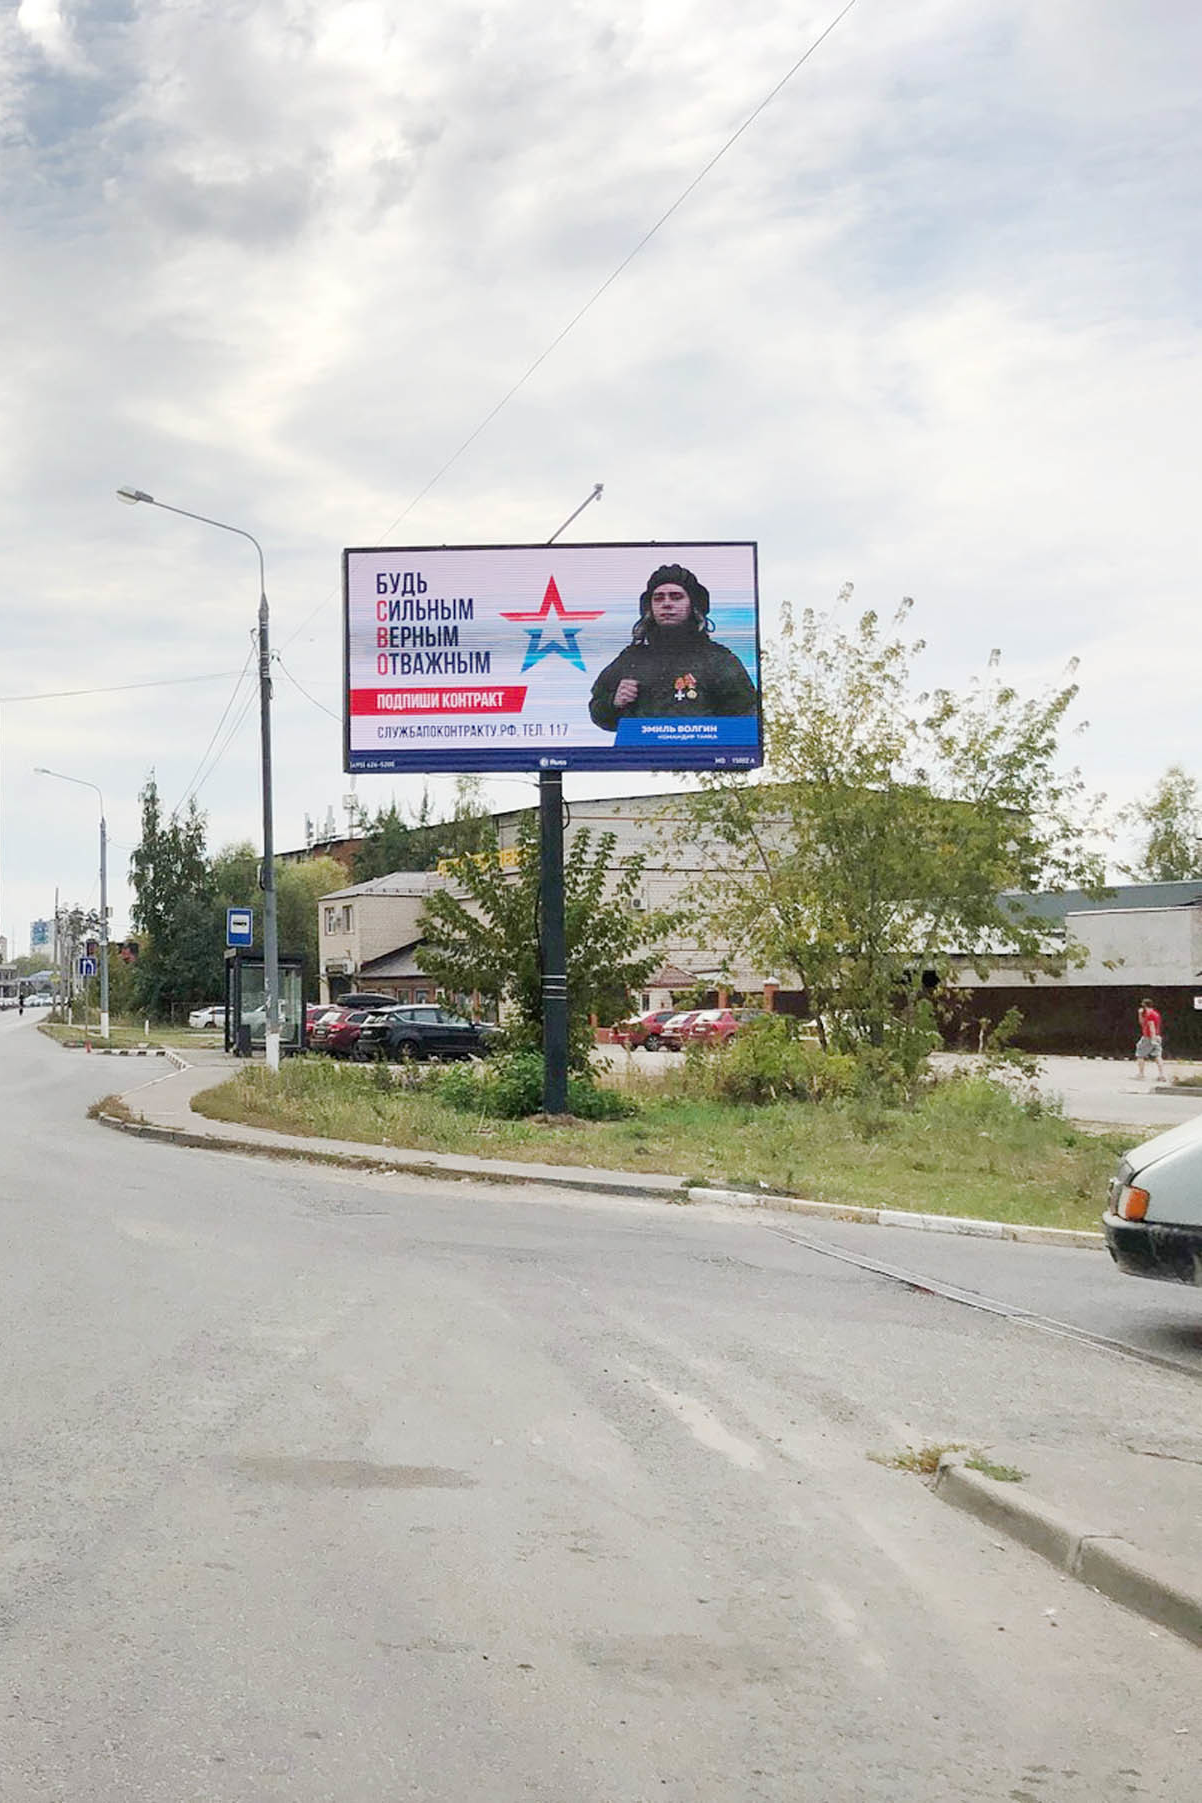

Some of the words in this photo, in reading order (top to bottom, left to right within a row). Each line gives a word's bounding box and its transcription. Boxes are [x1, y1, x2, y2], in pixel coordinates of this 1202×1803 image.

[376, 572, 428, 597] БУДЬ
[376, 598, 474, 622] СИЛЬНЫМ
[376, 625, 459, 648] ВЕРНЫМ
[377, 651, 491, 676] ОТВАЖНЫМ
[376, 693, 439, 710] ПОДПИШИ
[442, 691, 505, 708] КОНТРАКТ
[523, 724, 546, 737] ТЕЛ.
[550, 723, 569, 736] 117
[641, 725, 677, 734] ЭМИЛЬ
[677, 725, 718, 733] ВОЛГИН
